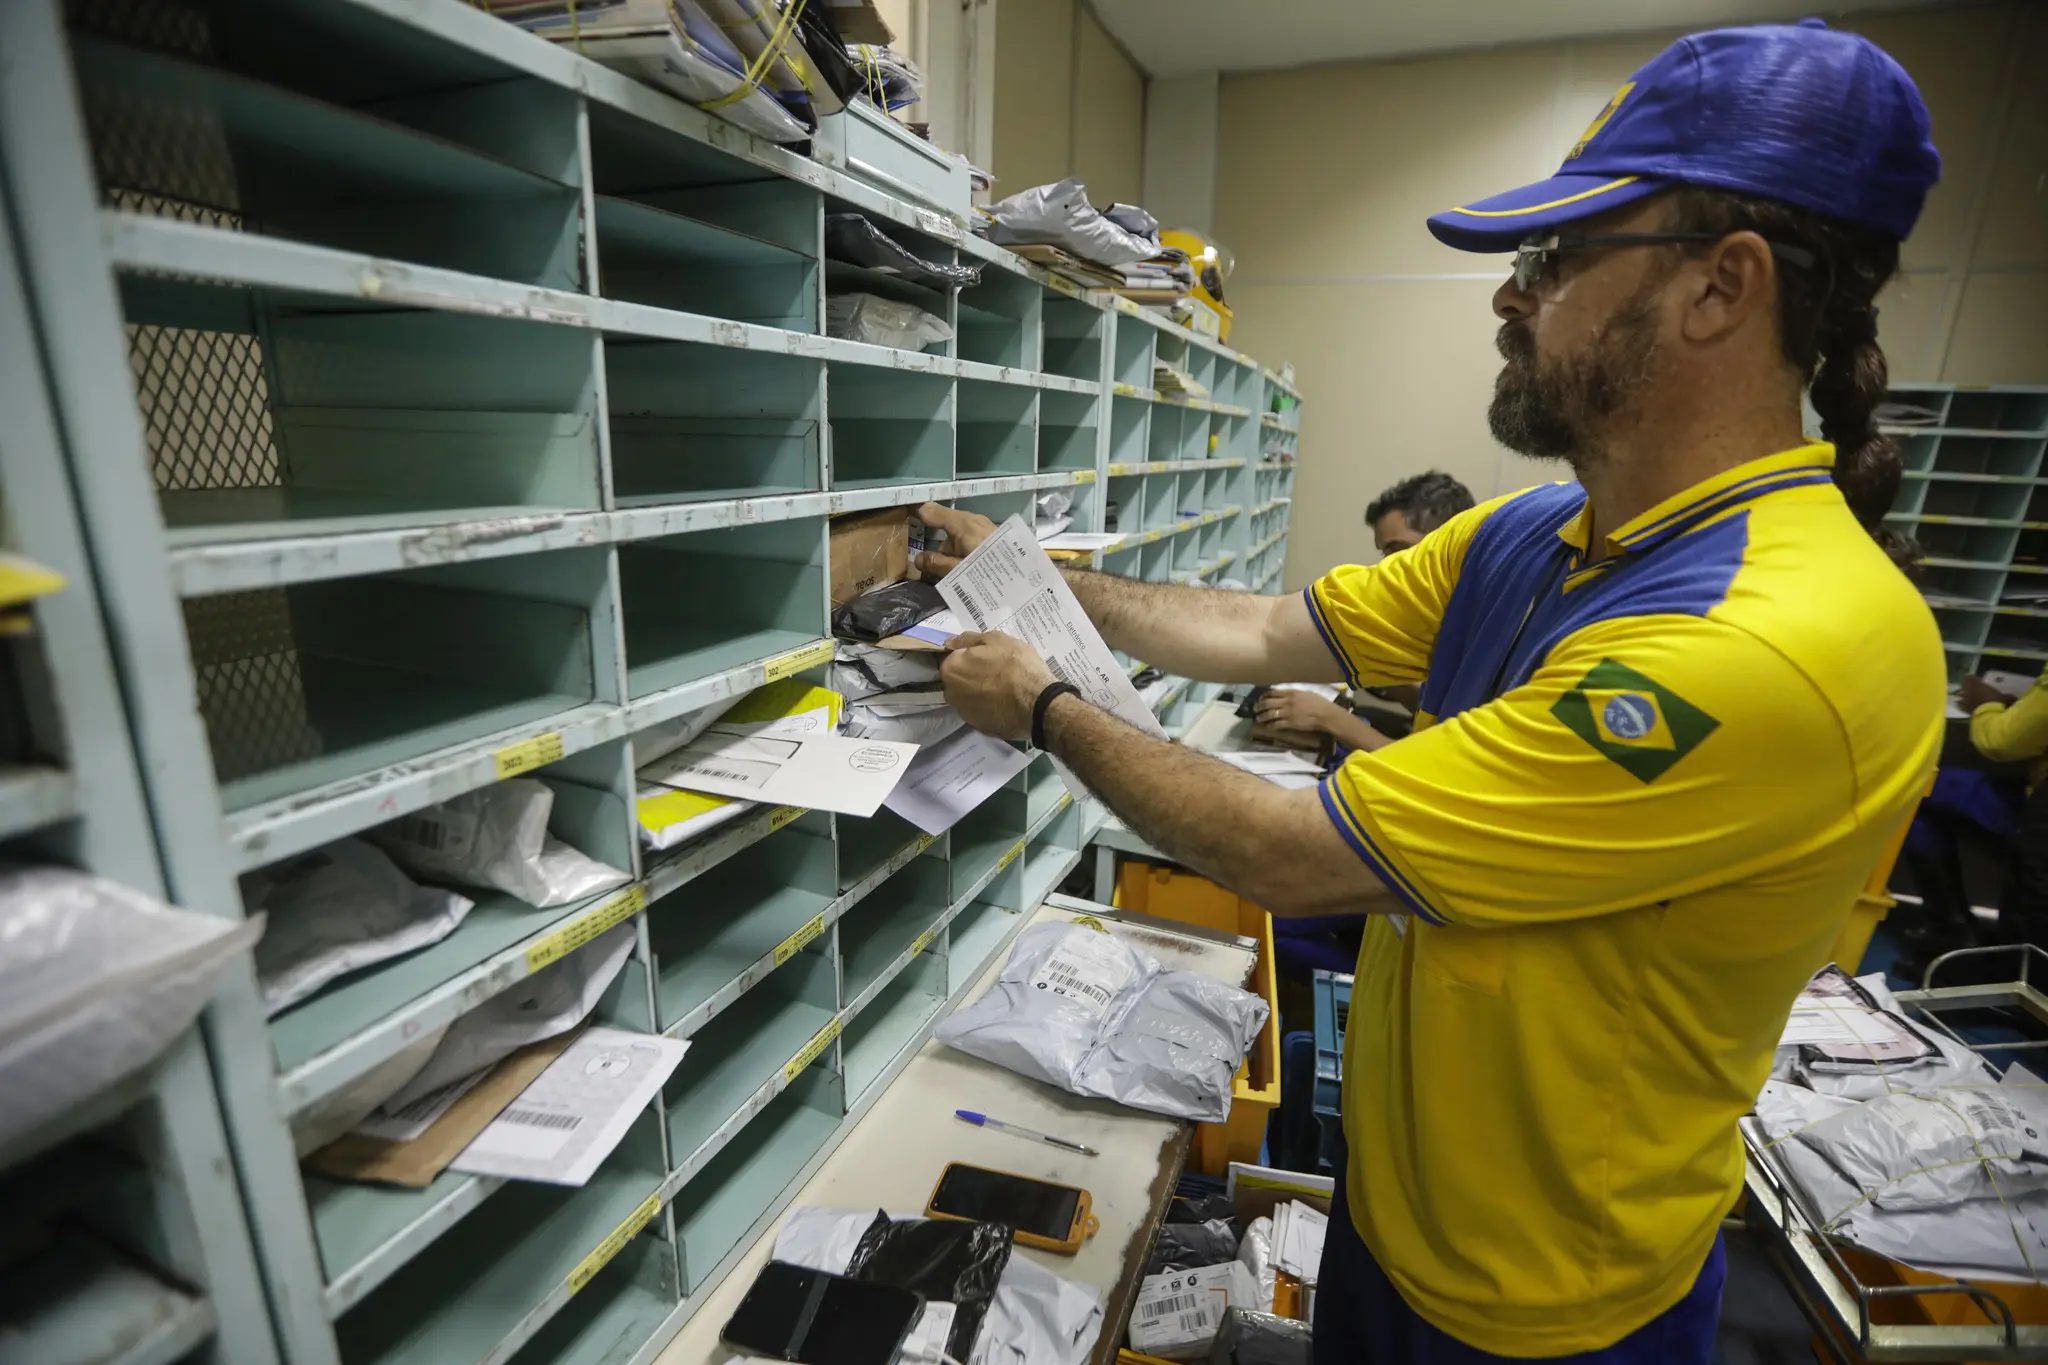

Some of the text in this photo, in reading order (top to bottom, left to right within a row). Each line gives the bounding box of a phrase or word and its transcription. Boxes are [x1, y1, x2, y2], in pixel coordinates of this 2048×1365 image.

[1066, 621, 1086, 650] Eletrônico
[768, 666, 779, 678] 302
[1100, 673, 1110, 683] AR
